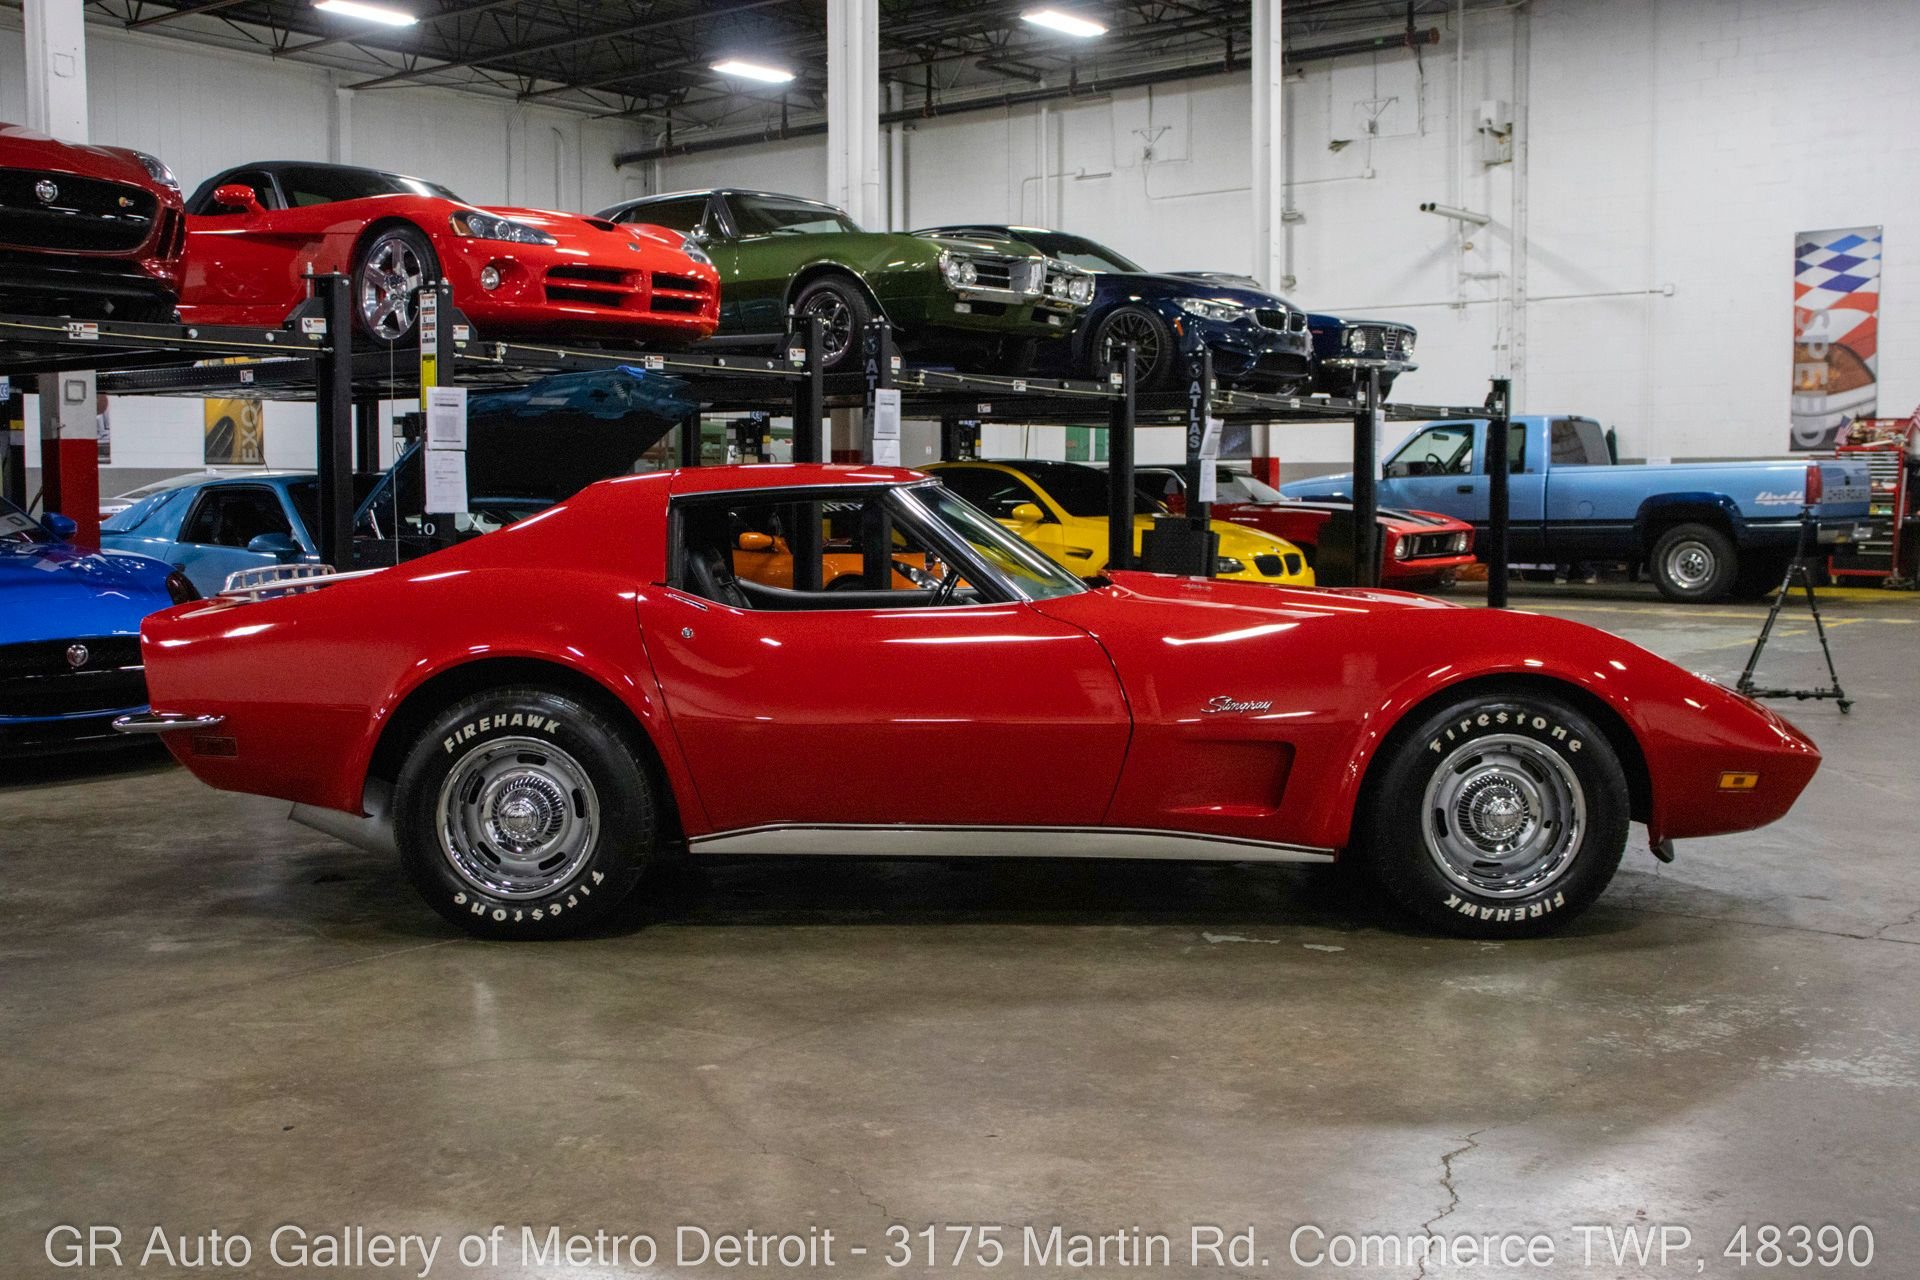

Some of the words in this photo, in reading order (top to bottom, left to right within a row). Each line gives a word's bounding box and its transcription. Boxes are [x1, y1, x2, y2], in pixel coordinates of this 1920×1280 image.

[1793, 308, 1830, 447] SPEED
[1189, 381, 1201, 448] ATLAS
[1201, 696, 1273, 713] Stingray
[443, 713, 561, 754] FIREHAWK
[1443, 891, 1565, 921] FIREHAWK
